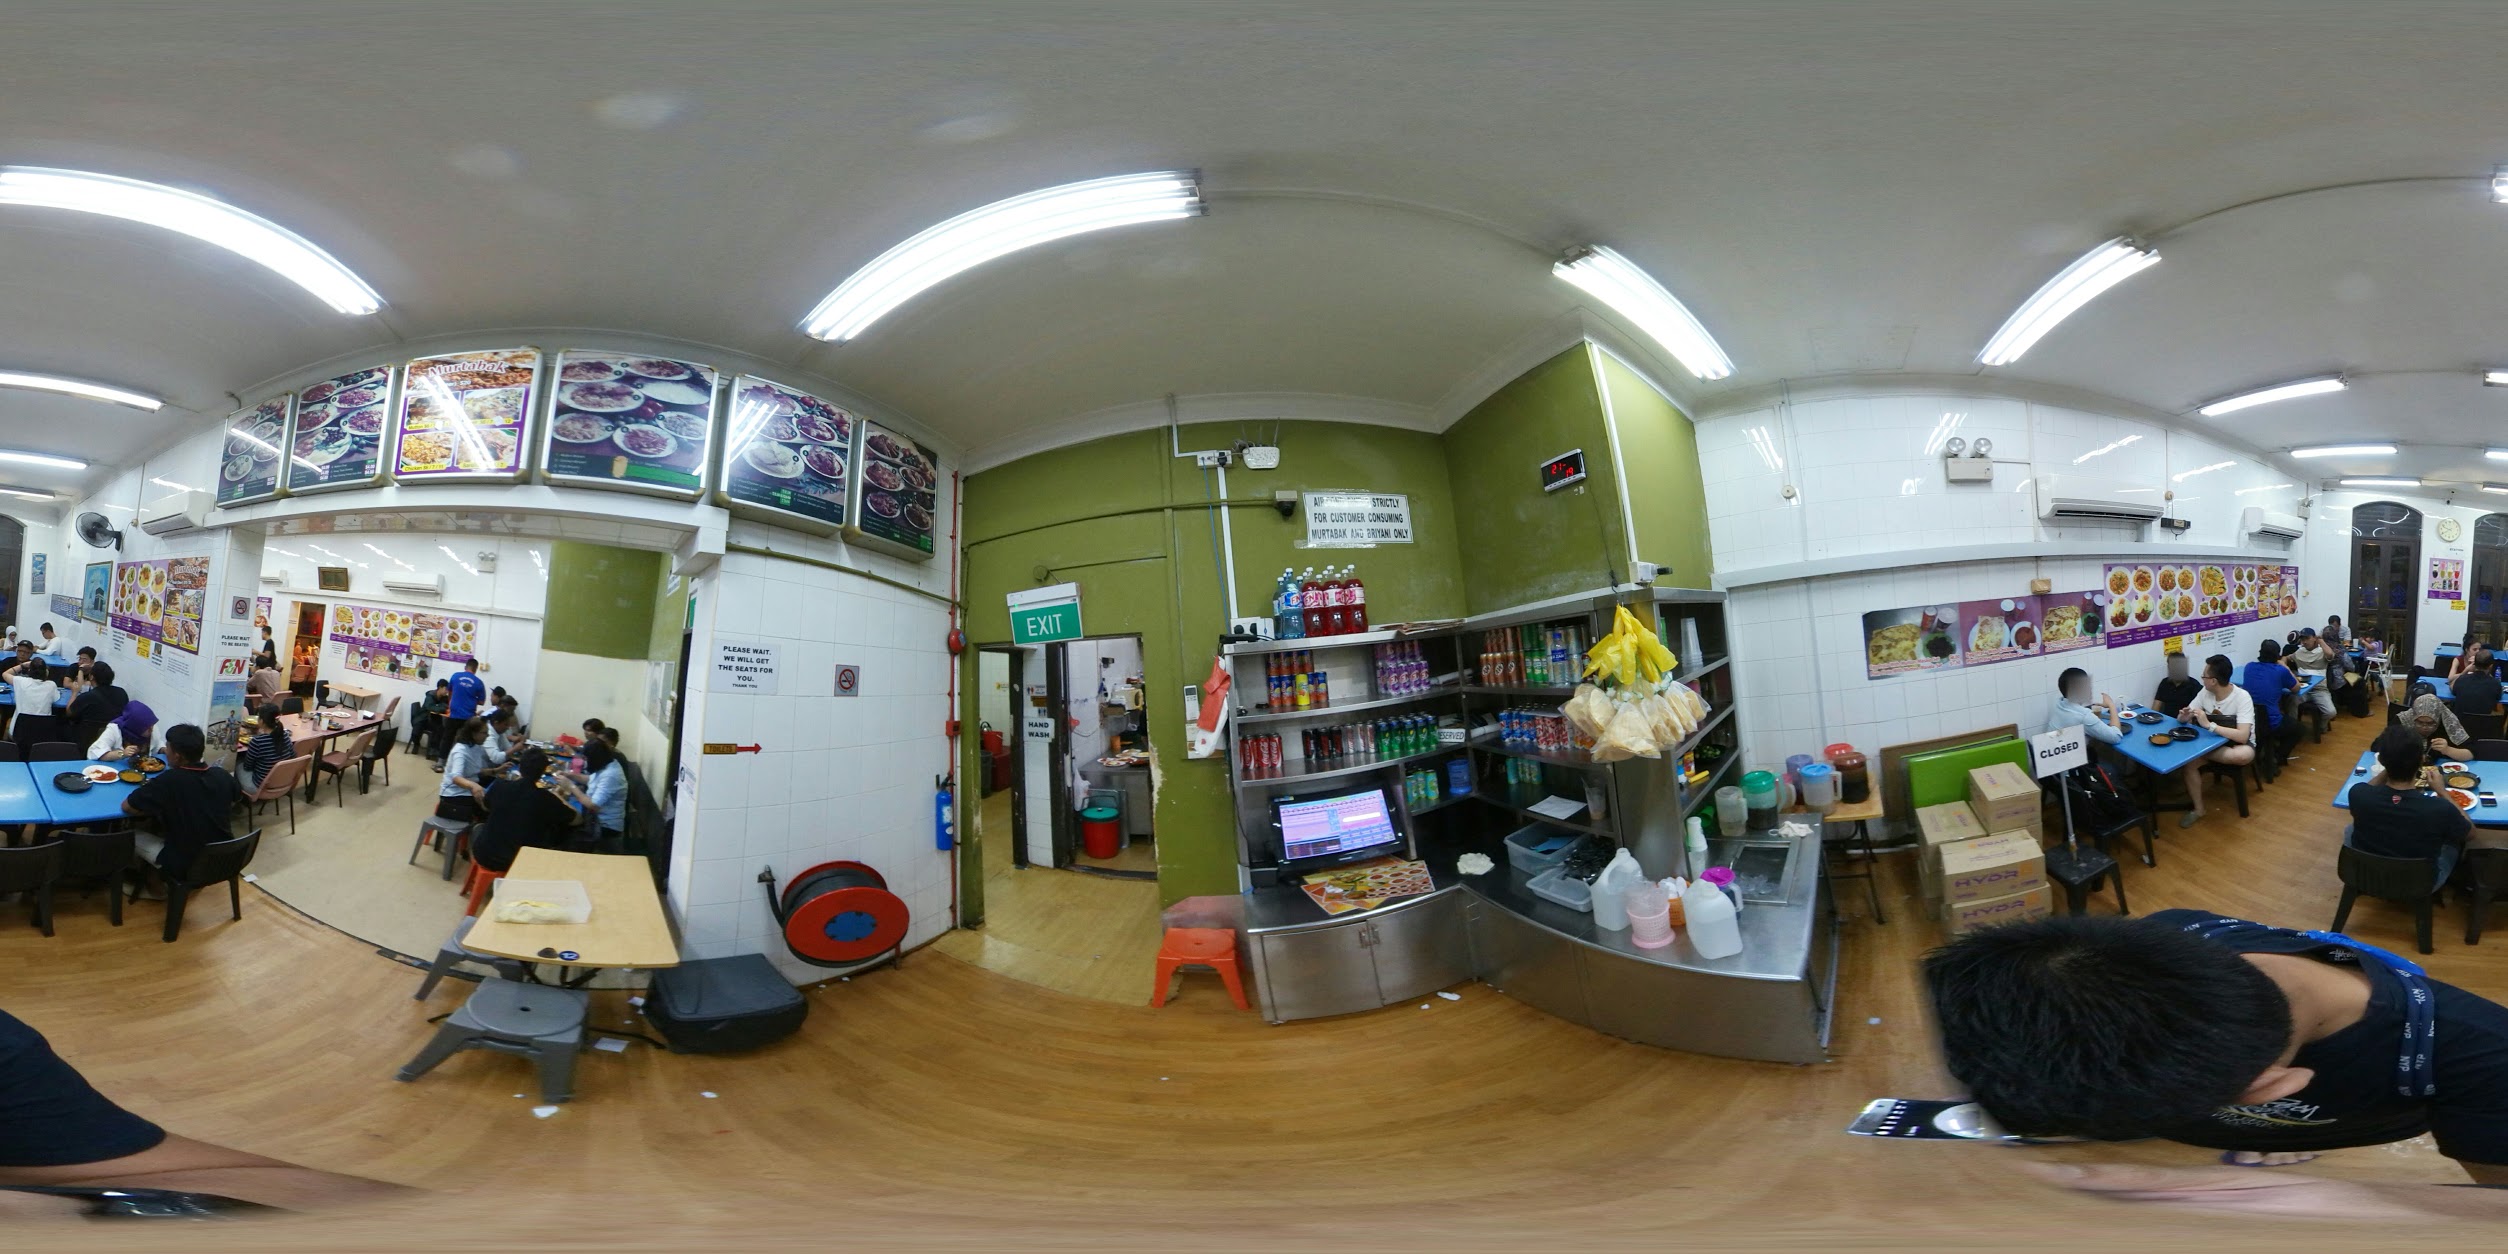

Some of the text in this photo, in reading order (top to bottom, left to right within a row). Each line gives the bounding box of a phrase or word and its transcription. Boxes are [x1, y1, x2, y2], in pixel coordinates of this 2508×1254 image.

[428, 360, 505, 377] Murtabak
[1372, 498, 1399, 508] STRICTLY
[1314, 513, 1403, 523] FOR CUSTOMER CONSUMING
[1312, 529, 1408, 539] MURTABAK AND BRIYANI ONLY
[1026, 614, 1062, 636] EXIT
[220, 659, 246, 674] F&N
[2040, 742, 2079, 758] CLOSED
[2400, 1056, 2410, 1072] NYP
